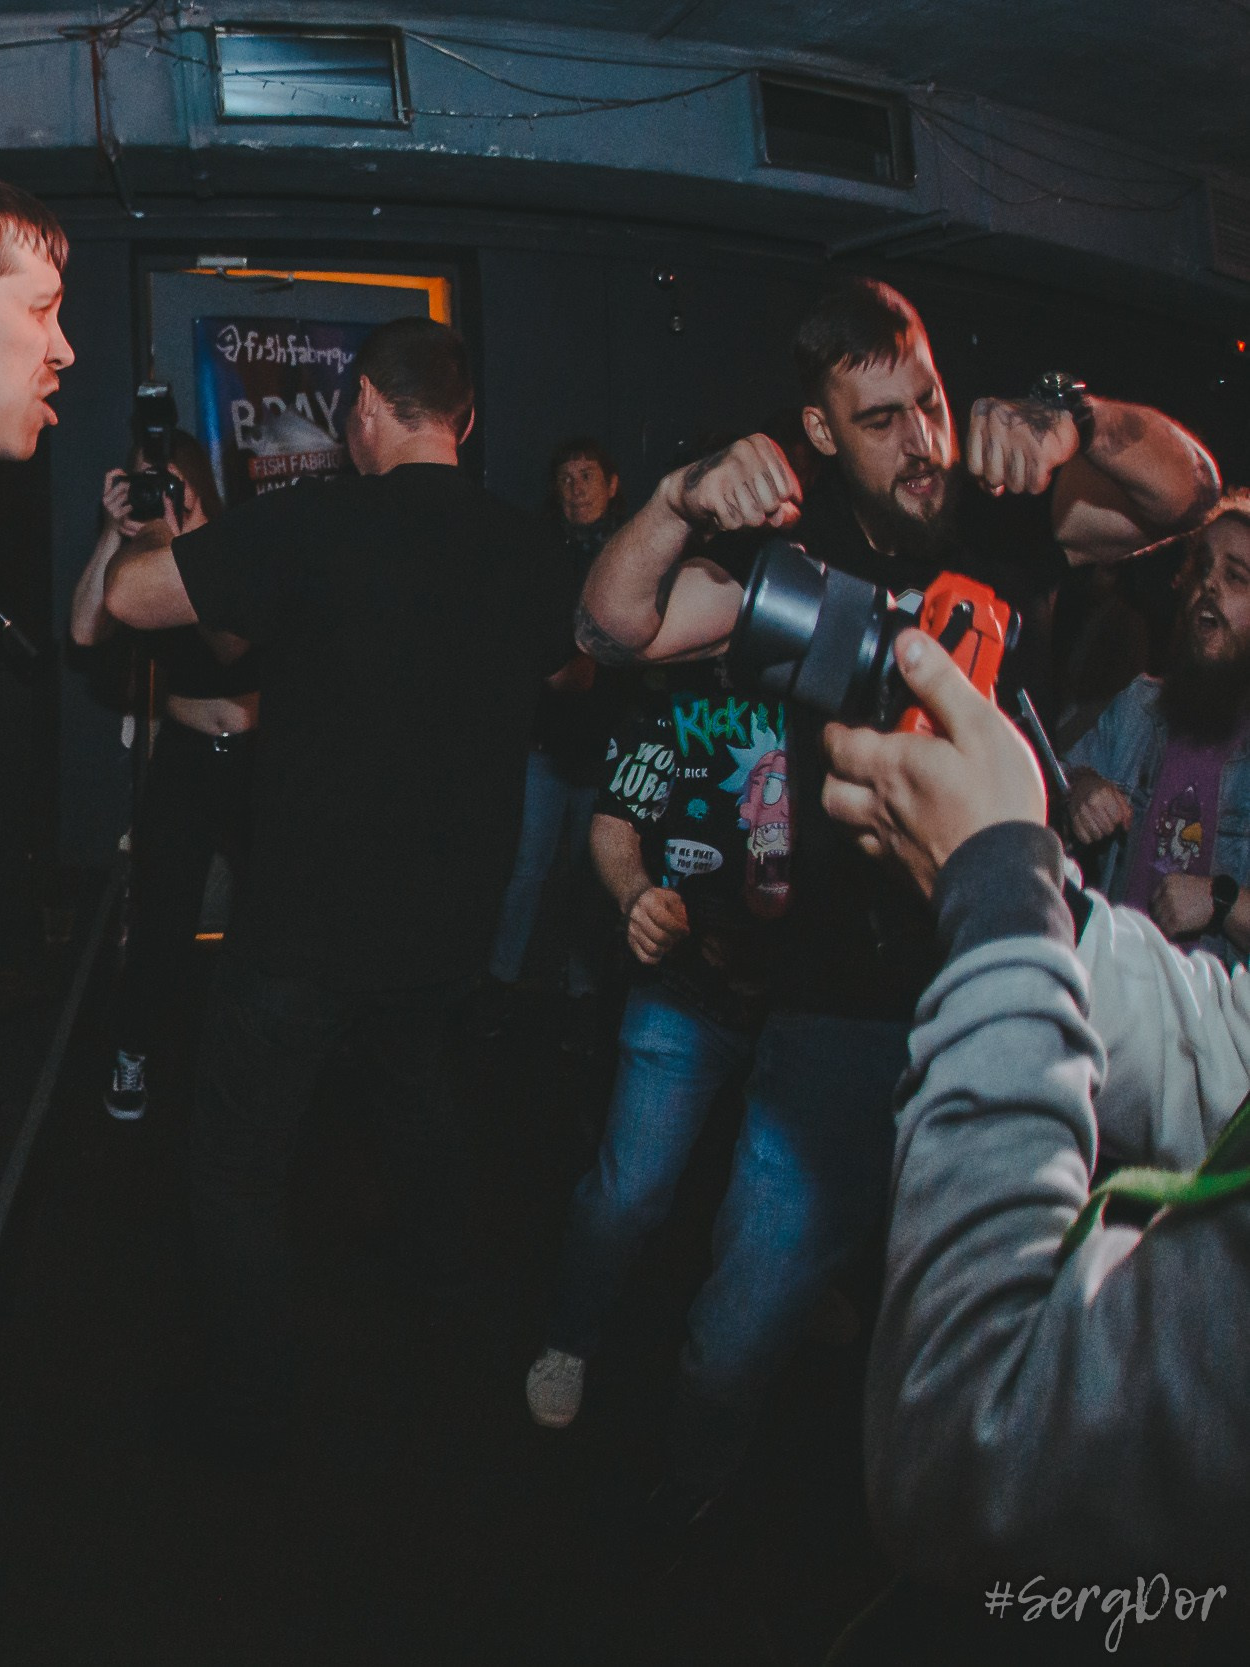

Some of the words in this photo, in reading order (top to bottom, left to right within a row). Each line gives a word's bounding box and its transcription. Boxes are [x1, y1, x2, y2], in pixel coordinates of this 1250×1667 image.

[253, 457, 287, 478] FISH
[684, 767, 709, 779] RICK
[693, 849, 714, 860] WHAT
[677, 858, 691, 868] YOU
